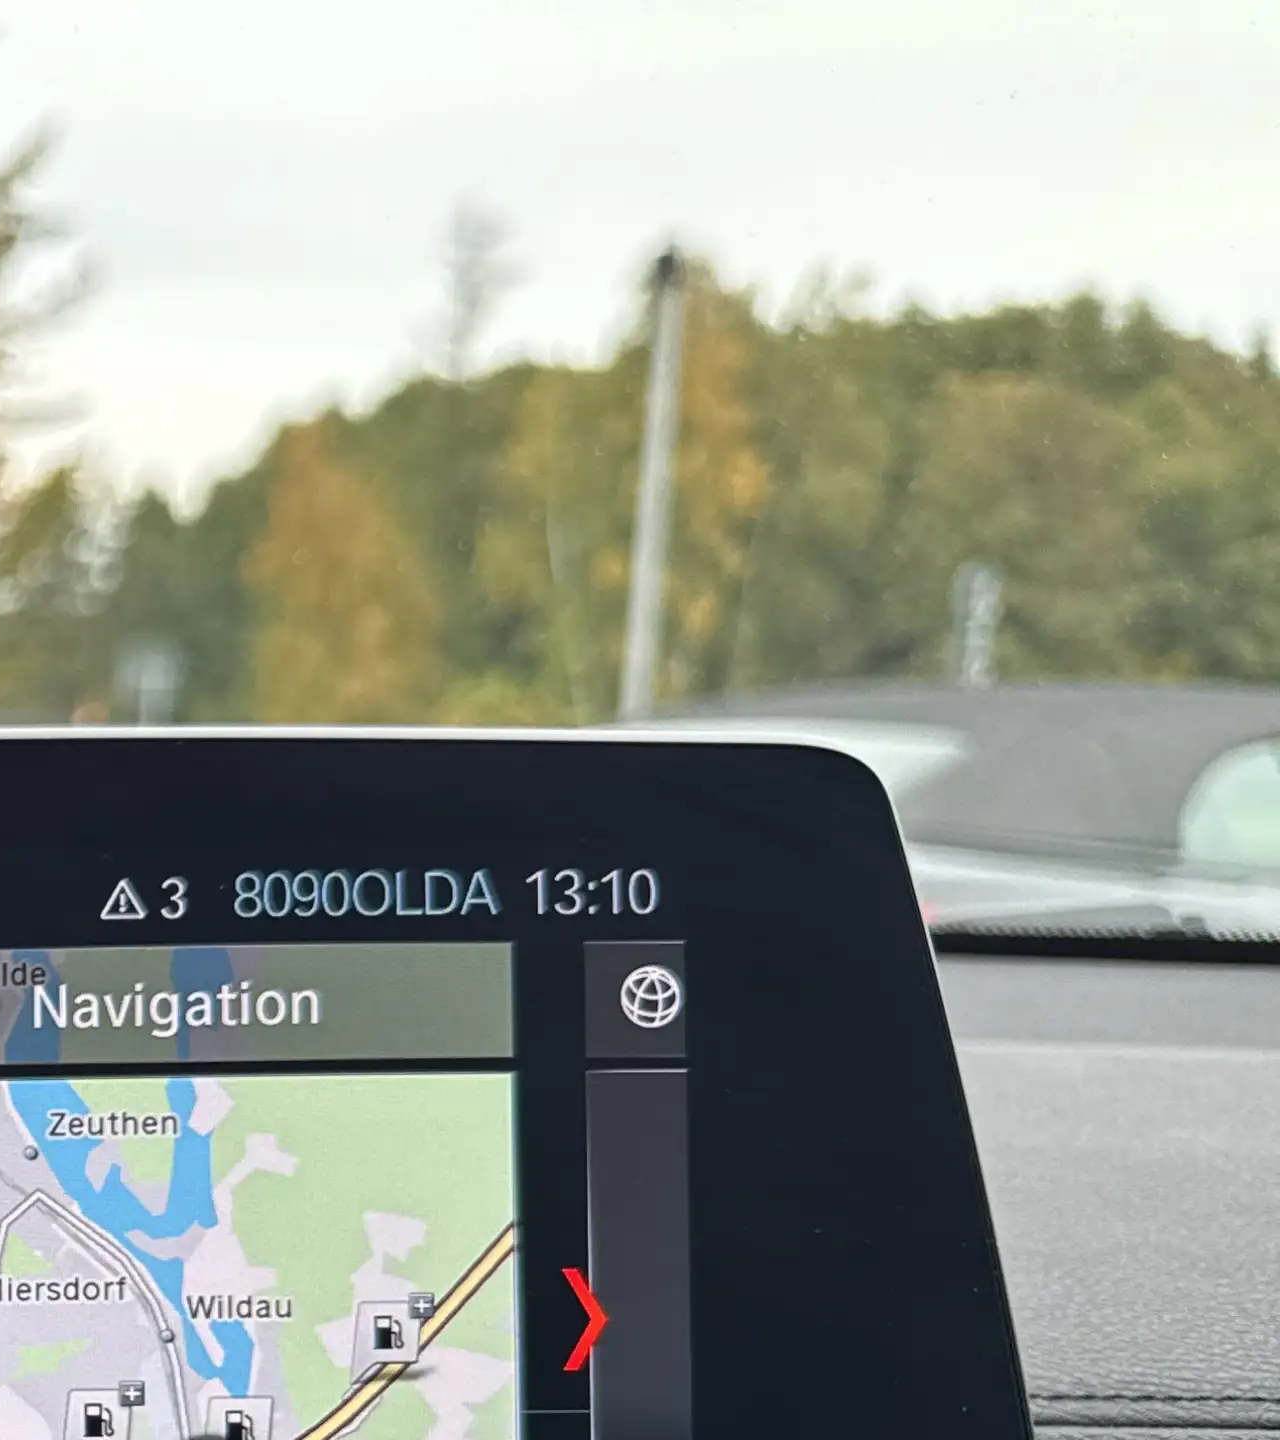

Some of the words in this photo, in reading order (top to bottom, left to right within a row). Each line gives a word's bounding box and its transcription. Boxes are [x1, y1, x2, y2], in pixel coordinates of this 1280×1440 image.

[160, 877, 188, 920] 3
[525, 868, 660, 916] 13:10
[33, 981, 321, 1038] Navigation
[48, 1110, 179, 1138] Zeuthen
[186, 1294, 293, 1320] Wildau
